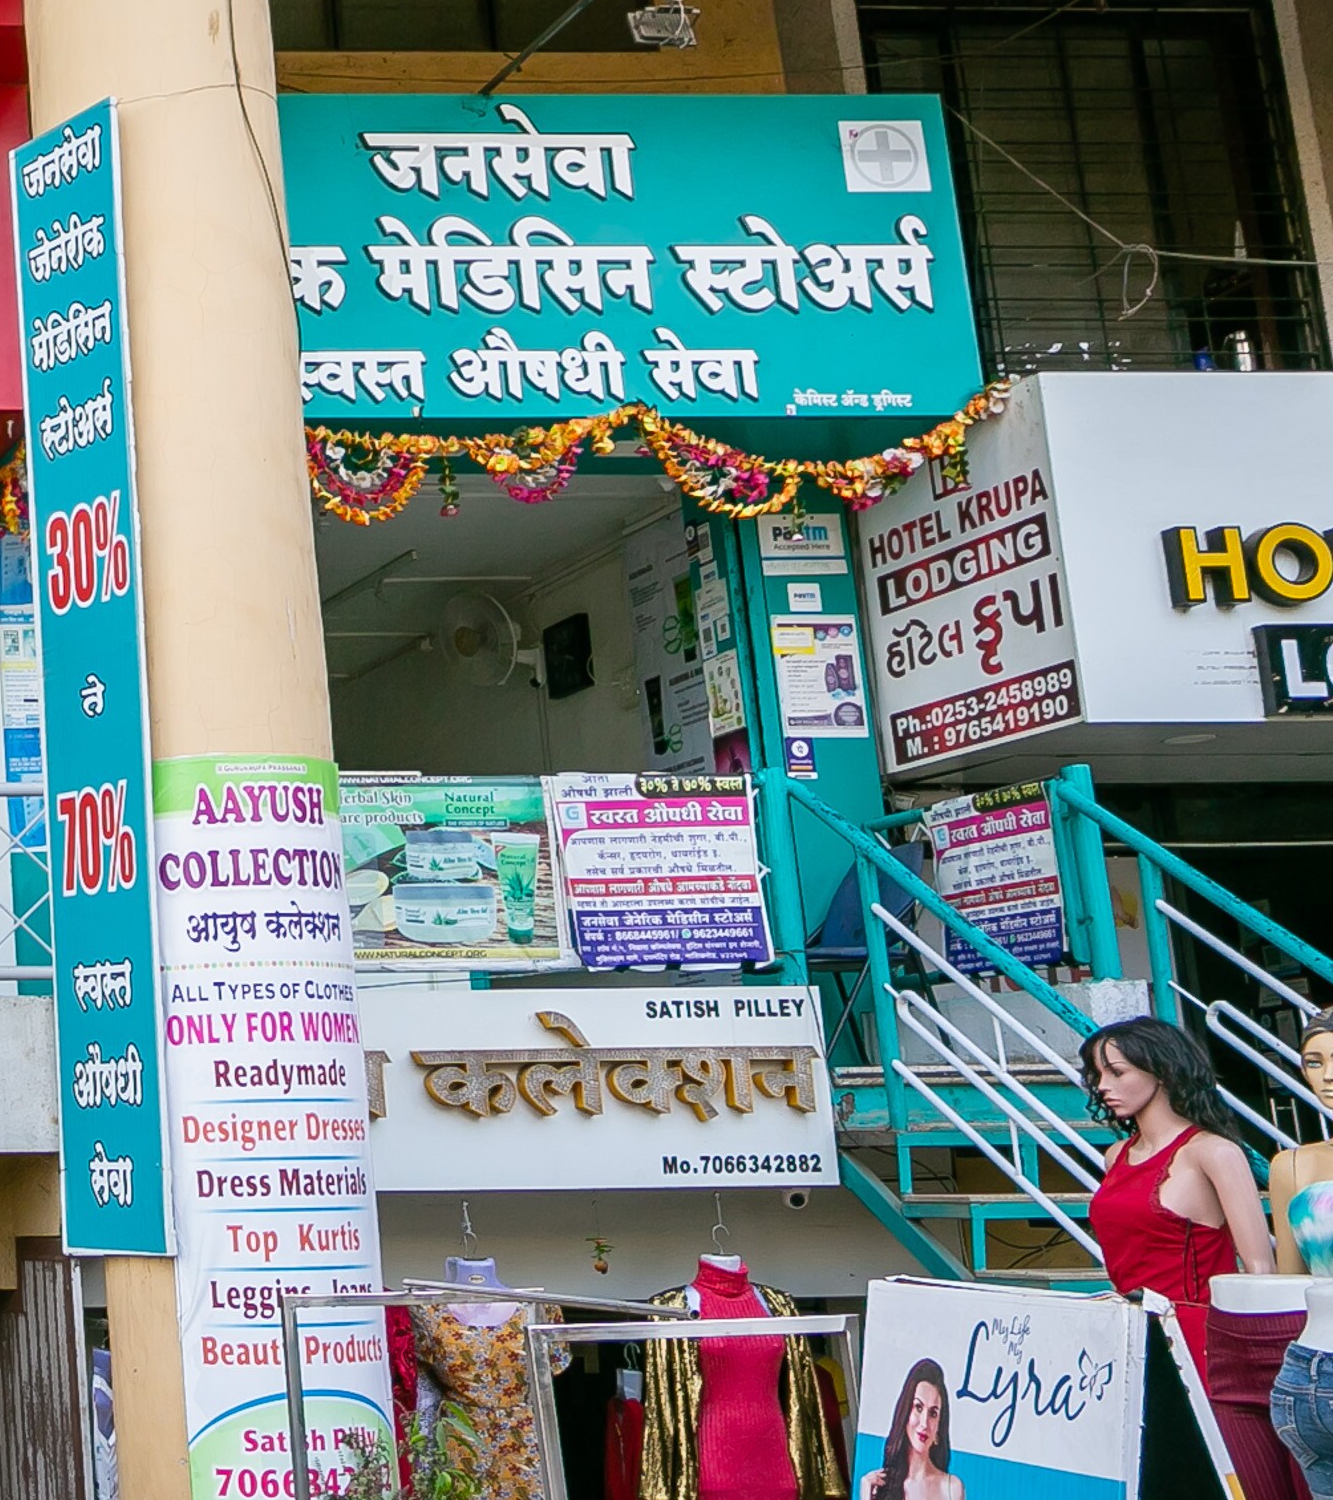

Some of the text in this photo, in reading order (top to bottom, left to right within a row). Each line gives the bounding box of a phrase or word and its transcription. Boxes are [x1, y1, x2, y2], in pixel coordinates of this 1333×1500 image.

[22, 123, 103, 198] जनसेवा
[358, 102, 635, 202] जनसेवा
[366, 214, 654, 314] मेडिसिन
[670, 214, 936, 314] स्टोअर्स
[31, 300, 112, 373] मेडिसिन
[449, 326, 625, 403] औषधी
[641, 327, 760, 402] सेवा
[772, 525, 829, 541] Patm
[869, 509, 951, 569] HOTEL
[957, 467, 1049, 535] KRUPA
[45, 490, 129, 617] 30%
[774, 542, 831, 552] Accepted Here
[886, 523, 1044, 608] LODGING
[1162, 522, 1333, 609] HO
[79, 674, 106, 718] ते
[944, 696, 1069, 748] 9765419190
[192, 785, 324, 825] AAYUSH
[340, 810, 424, 825] are products
[382, 789, 412, 806] Skin
[445, 792, 494, 803] Natural
[445, 805, 495, 817] Concept
[590, 809, 638, 824] स्वस्त
[706, 801, 743, 820] सेवा
[56, 779, 137, 898] 70%
[159, 848, 342, 891] COLLECTION
[187, 911, 257, 951] आयुष
[72, 956, 132, 1014] स्वस्त
[171, 980, 354, 1002] ALL TYPES OF CLOTHES
[167, 1011, 359, 1046] ONLY FOR WOMEN
[645, 998, 805, 1019] SATISH PILLEY
[72, 1041, 144, 1110] औषधी
[213, 1058, 346, 1093] Readymade
[183, 1112, 365, 1151] Designer Dresses
[89, 1139, 133, 1210] सेवा
[197, 1165, 367, 1198] Dress Materials
[662, 1154, 823, 1176] Mo.7066342882
[227, 1221, 360, 1262] Top Kurtis
[201, 1334, 383, 1366] Beaut Products
[991, 1315, 1031, 1345] My Life
[1007, 1341, 1023, 1365] My
[956, 1320, 1086, 1447] Lyra
